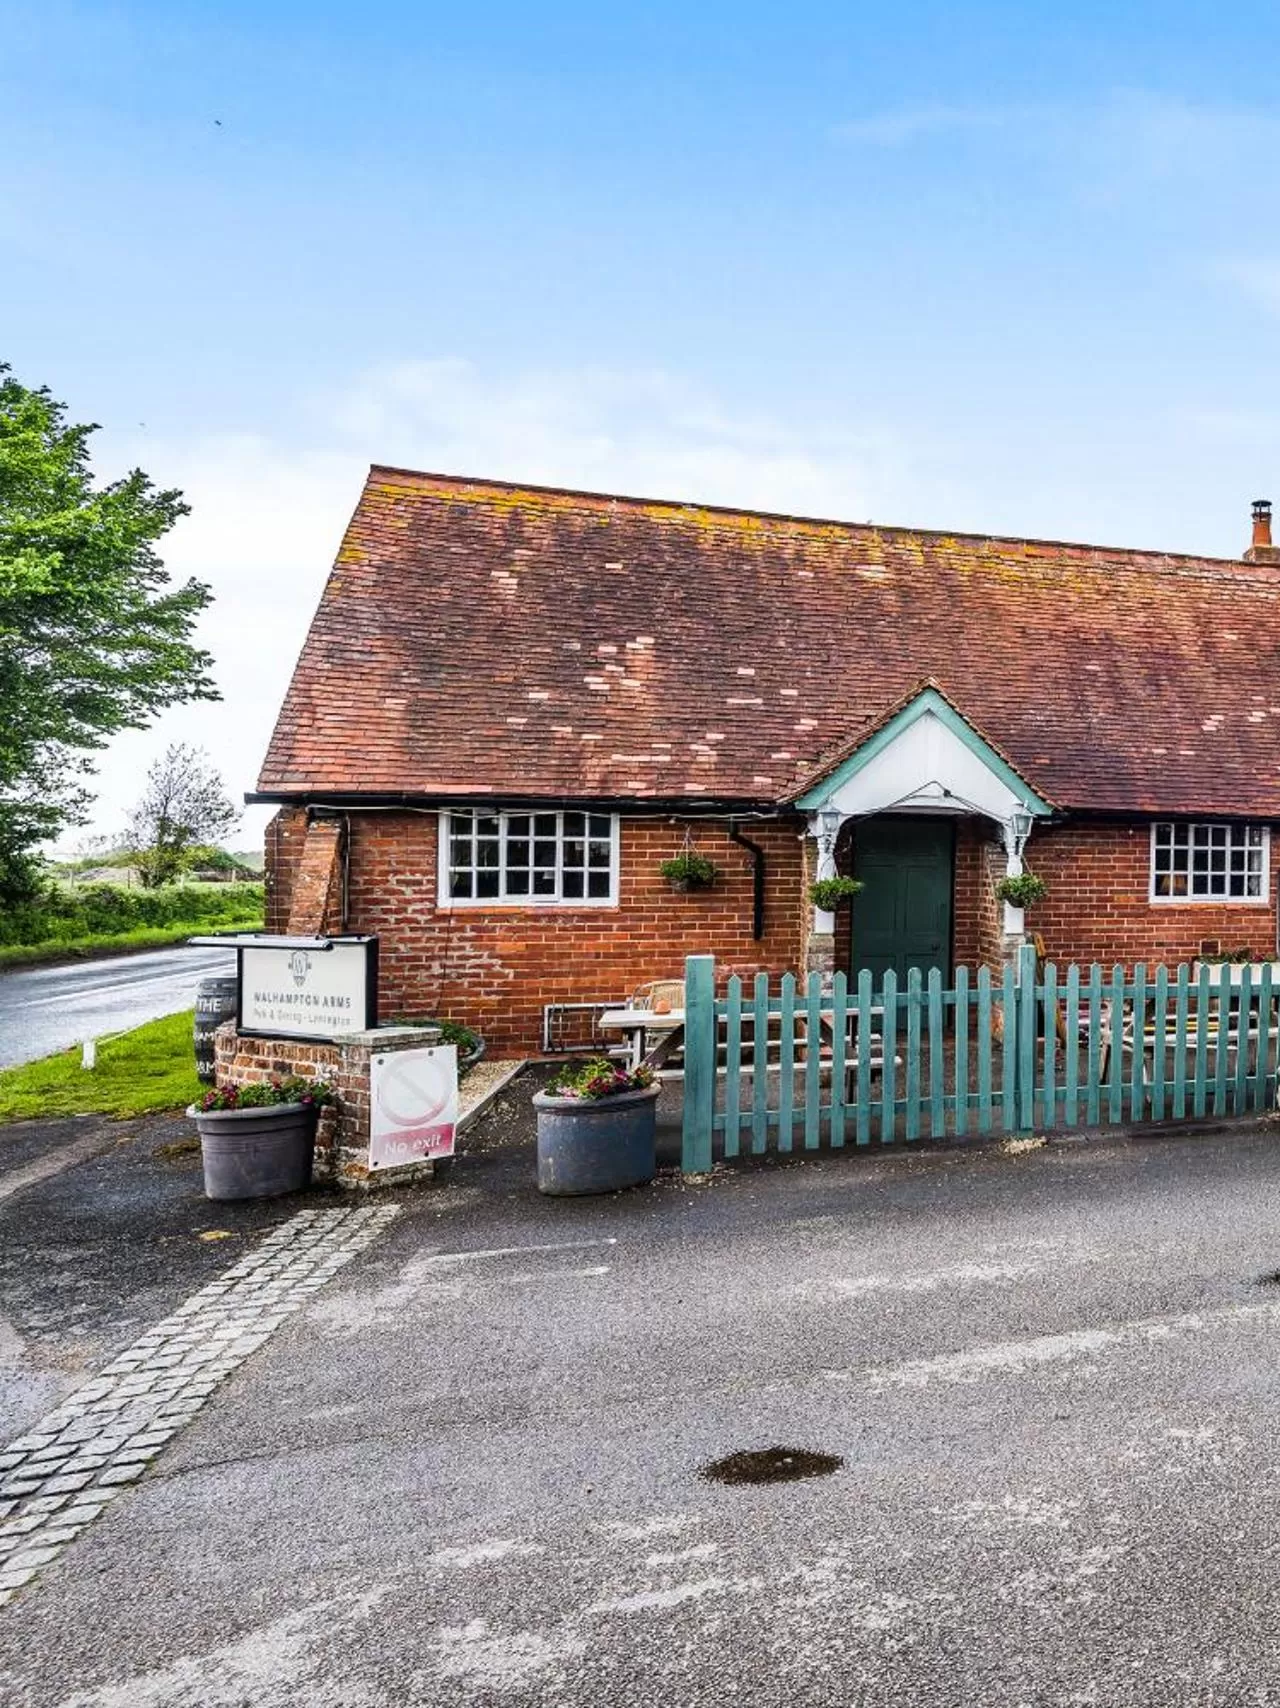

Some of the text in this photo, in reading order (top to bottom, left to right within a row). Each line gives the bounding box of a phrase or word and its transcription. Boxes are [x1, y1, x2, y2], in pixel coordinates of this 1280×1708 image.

[253, 991, 351, 1009] WALHAMPTON ARMS
[385, 1133, 441, 1156] No exit
